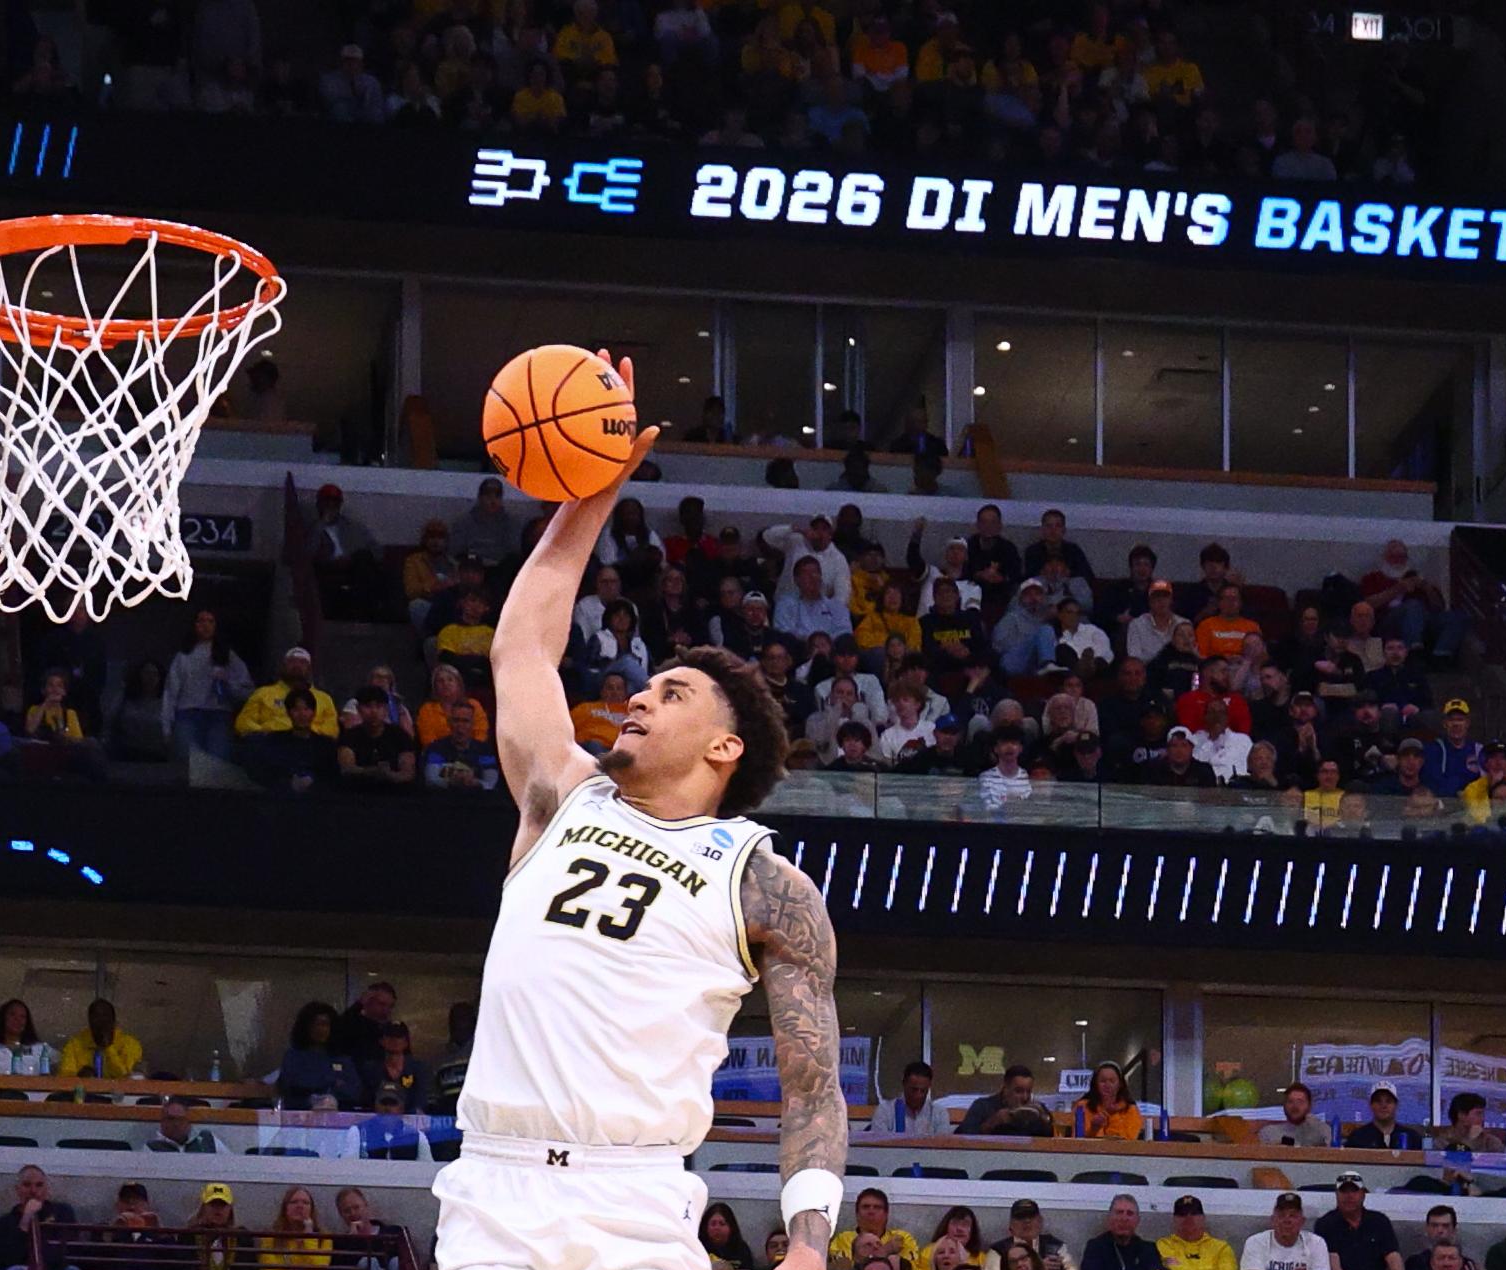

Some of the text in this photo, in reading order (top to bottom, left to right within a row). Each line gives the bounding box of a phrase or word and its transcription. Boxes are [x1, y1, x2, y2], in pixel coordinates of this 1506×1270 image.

[1354, 17, 1381, 36] EXIT
[690, 164, 885, 226] 2026
[906, 177, 993, 232] DI
[1013, 183, 1233, 245] MEN'S
[184, 519, 236, 545] 234
[557, 826, 707, 897] MICHIGAN
[545, 858, 661, 941] 23
[959, 1044, 1006, 1075] M
[547, 1149, 570, 1167] M
